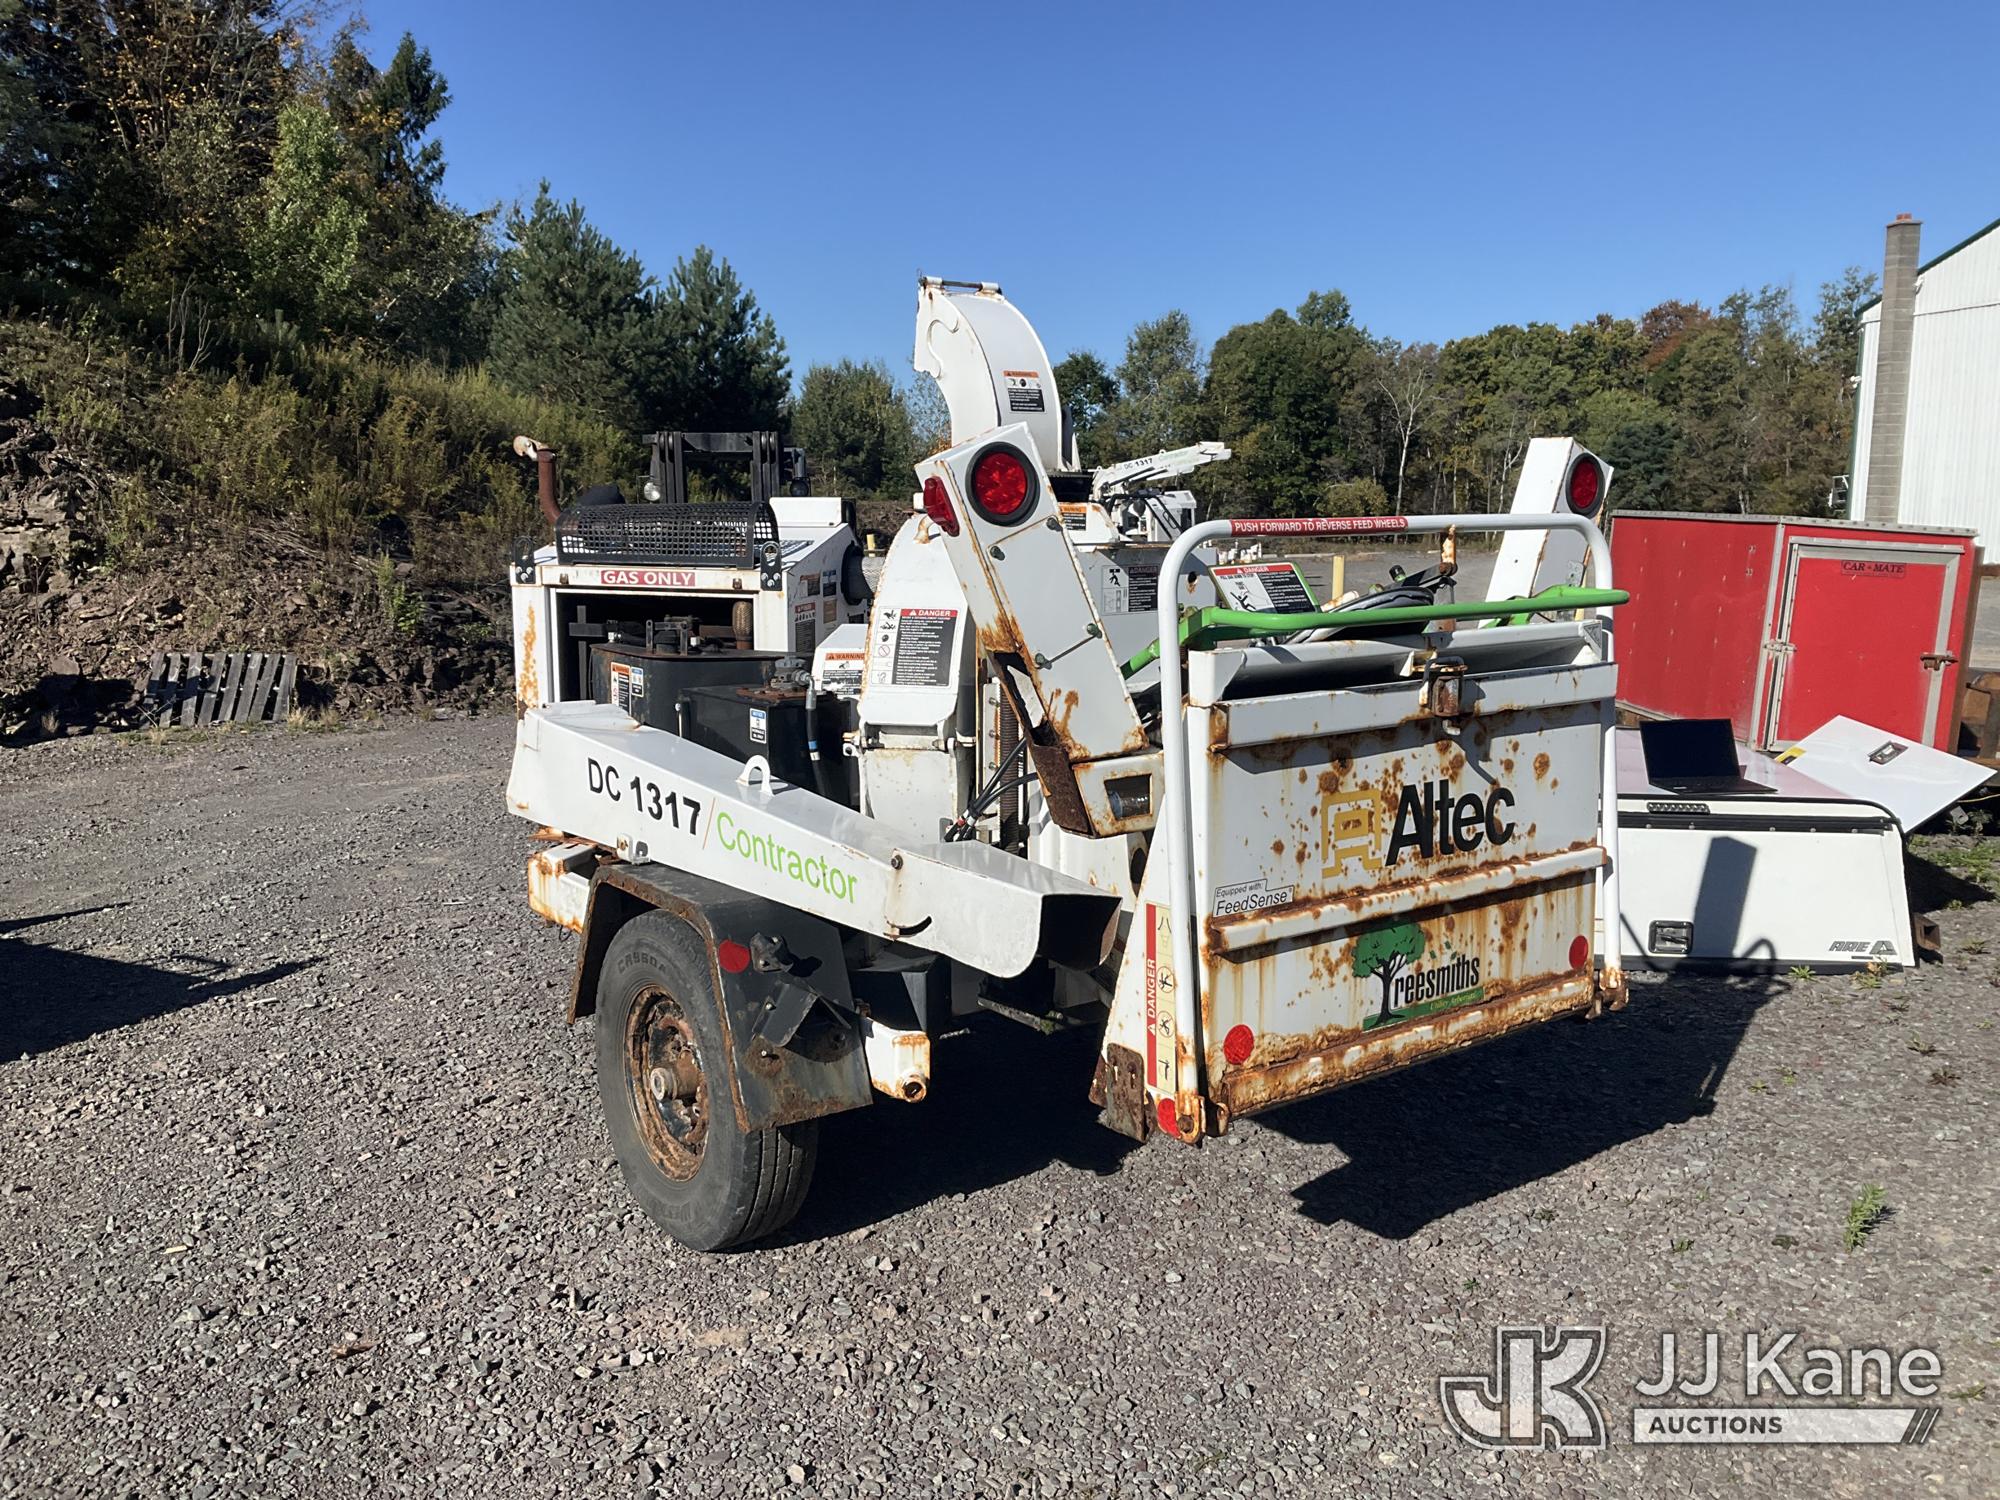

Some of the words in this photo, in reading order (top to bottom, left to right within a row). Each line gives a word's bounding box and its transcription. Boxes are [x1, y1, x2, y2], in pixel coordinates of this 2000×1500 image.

[1235, 521, 1258, 532] PUSH
[1260, 520, 1302, 532] FORWARD
[1302, 520, 1314, 531] TO
[1315, 519, 1351, 531] REVERSE
[1353, 518, 1373, 530] FEED
[1374, 517, 1406, 529] WHEELS
[1243, 565, 1270, 573] DANGER
[603, 570, 639, 584] GAS
[643, 571, 692, 586] ONLY
[918, 609, 951, 617] DANGER
[836, 652, 865, 660] WARNING
[588, 757, 621, 802] DC
[630, 775, 701, 836] 1317
[716, 811, 857, 903] Contractor
[1385, 778, 1515, 867] Altec
[1216, 885, 1247, 898] Equipped
[1147, 958, 1156, 1019] DANGER
